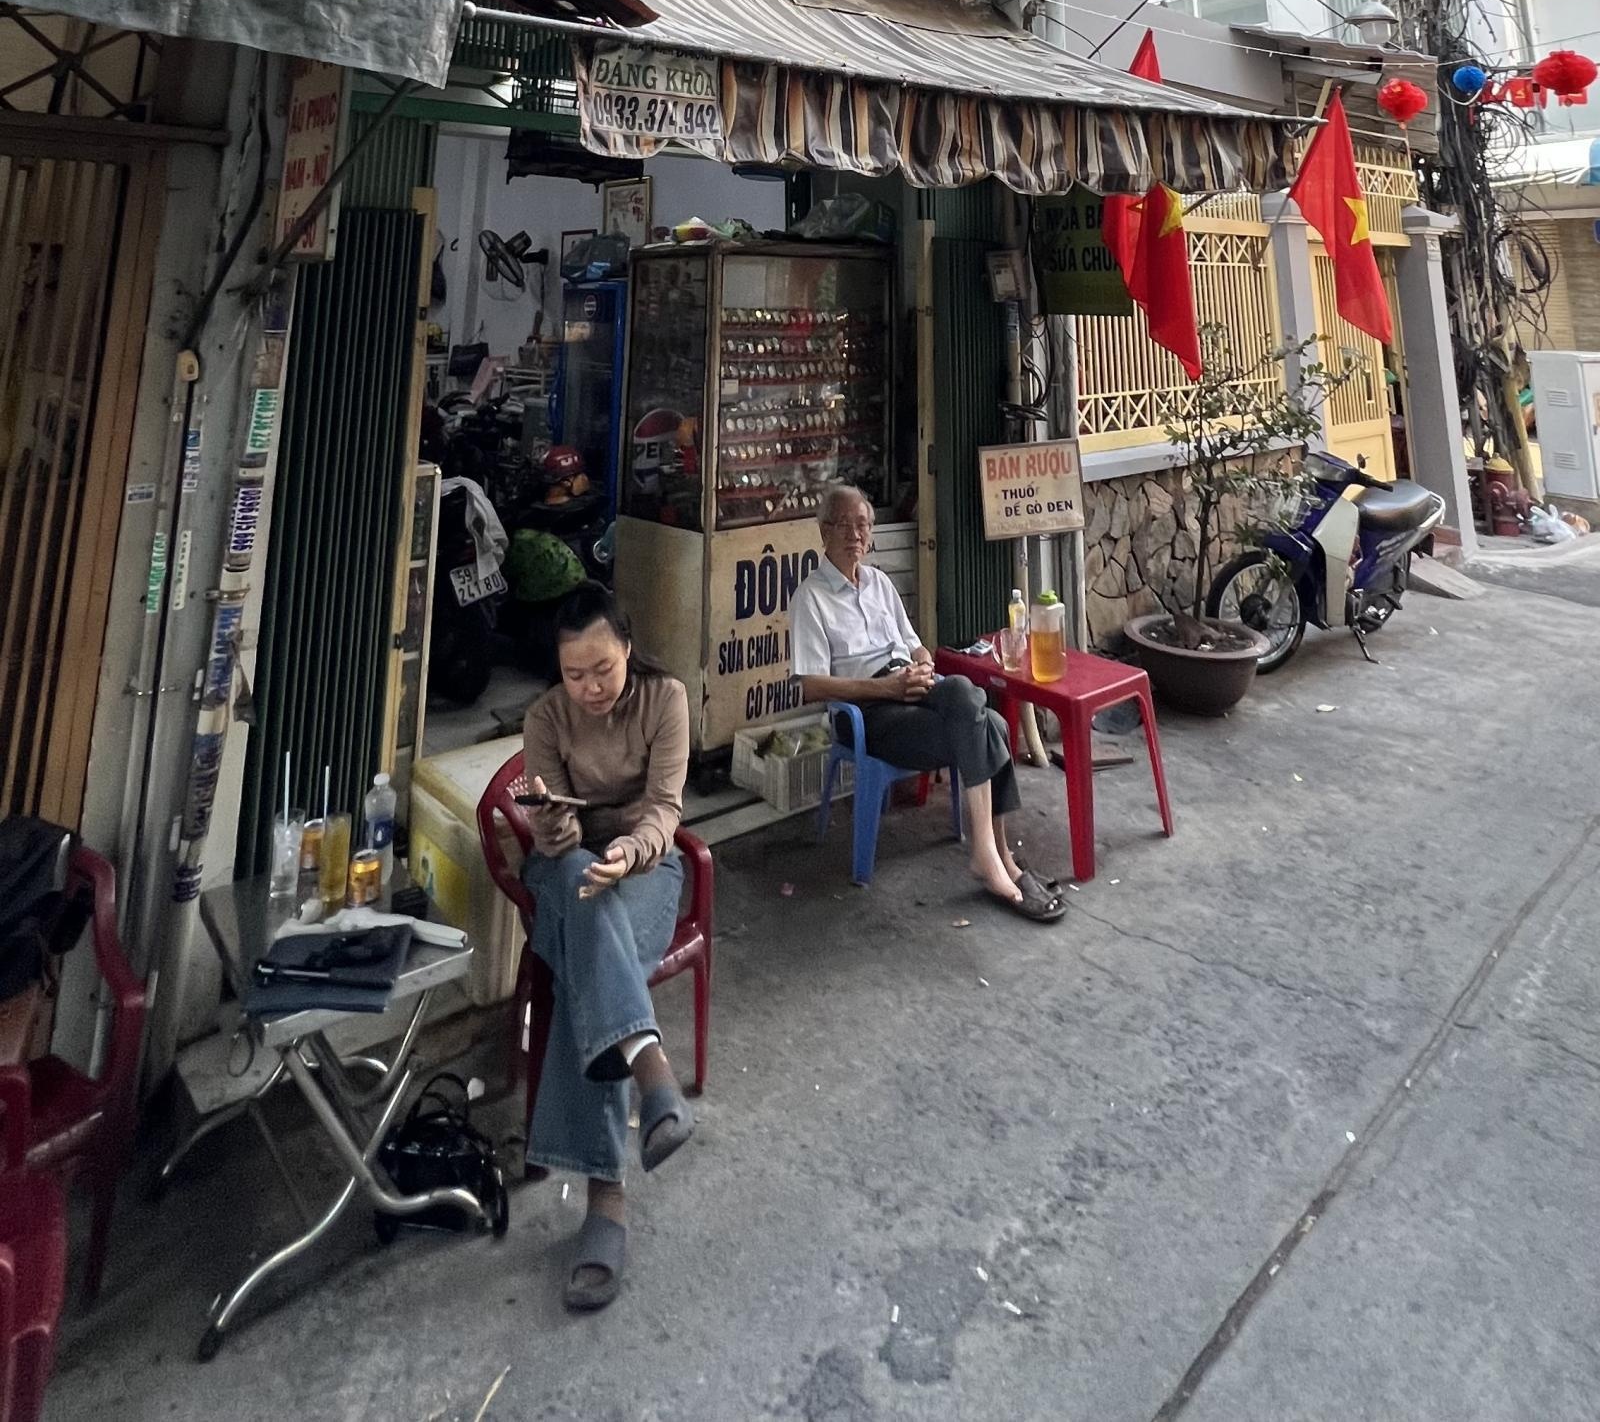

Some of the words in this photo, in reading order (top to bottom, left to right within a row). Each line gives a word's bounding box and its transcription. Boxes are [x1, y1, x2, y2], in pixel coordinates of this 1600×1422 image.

[986, 452, 1021, 481] BÁN
[1026, 447, 1073, 480] RƯỢU
[718, 629, 744, 676] SỬA
[745, 679, 763, 722] CÓ
